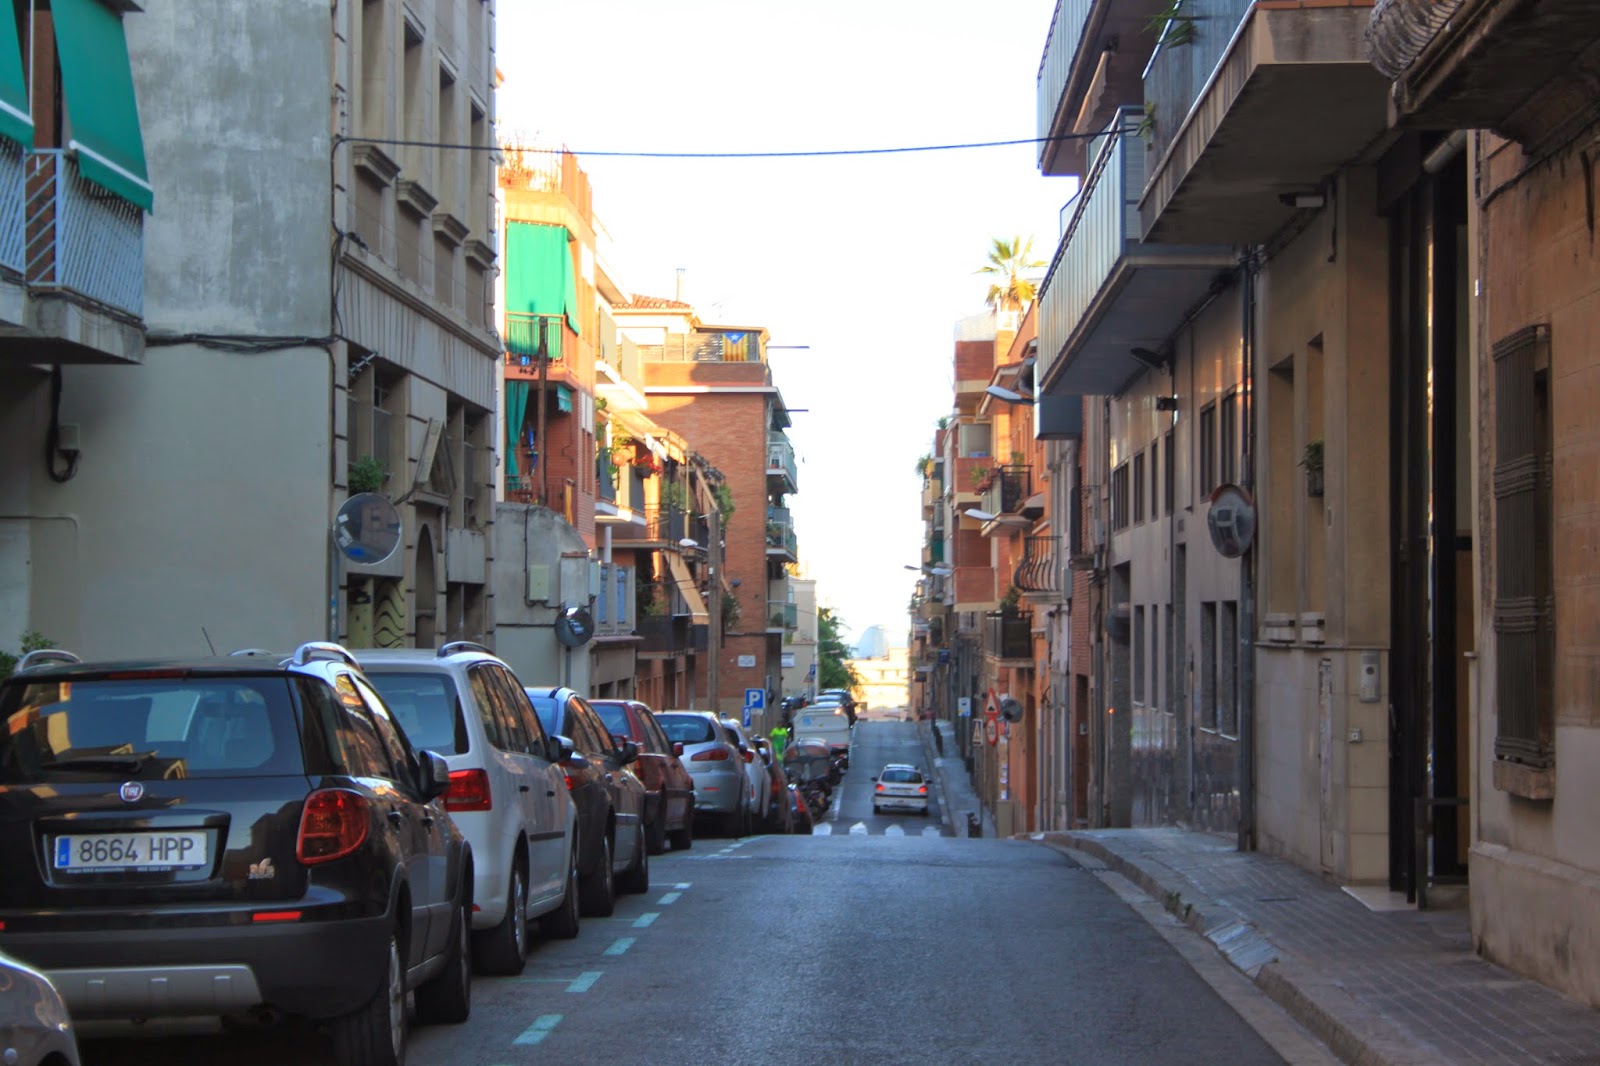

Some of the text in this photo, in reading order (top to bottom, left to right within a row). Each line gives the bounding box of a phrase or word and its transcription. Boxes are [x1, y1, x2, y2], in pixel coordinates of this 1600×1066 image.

[749, 691, 761, 707] P
[79, 837, 194, 862] 8664 HPP
